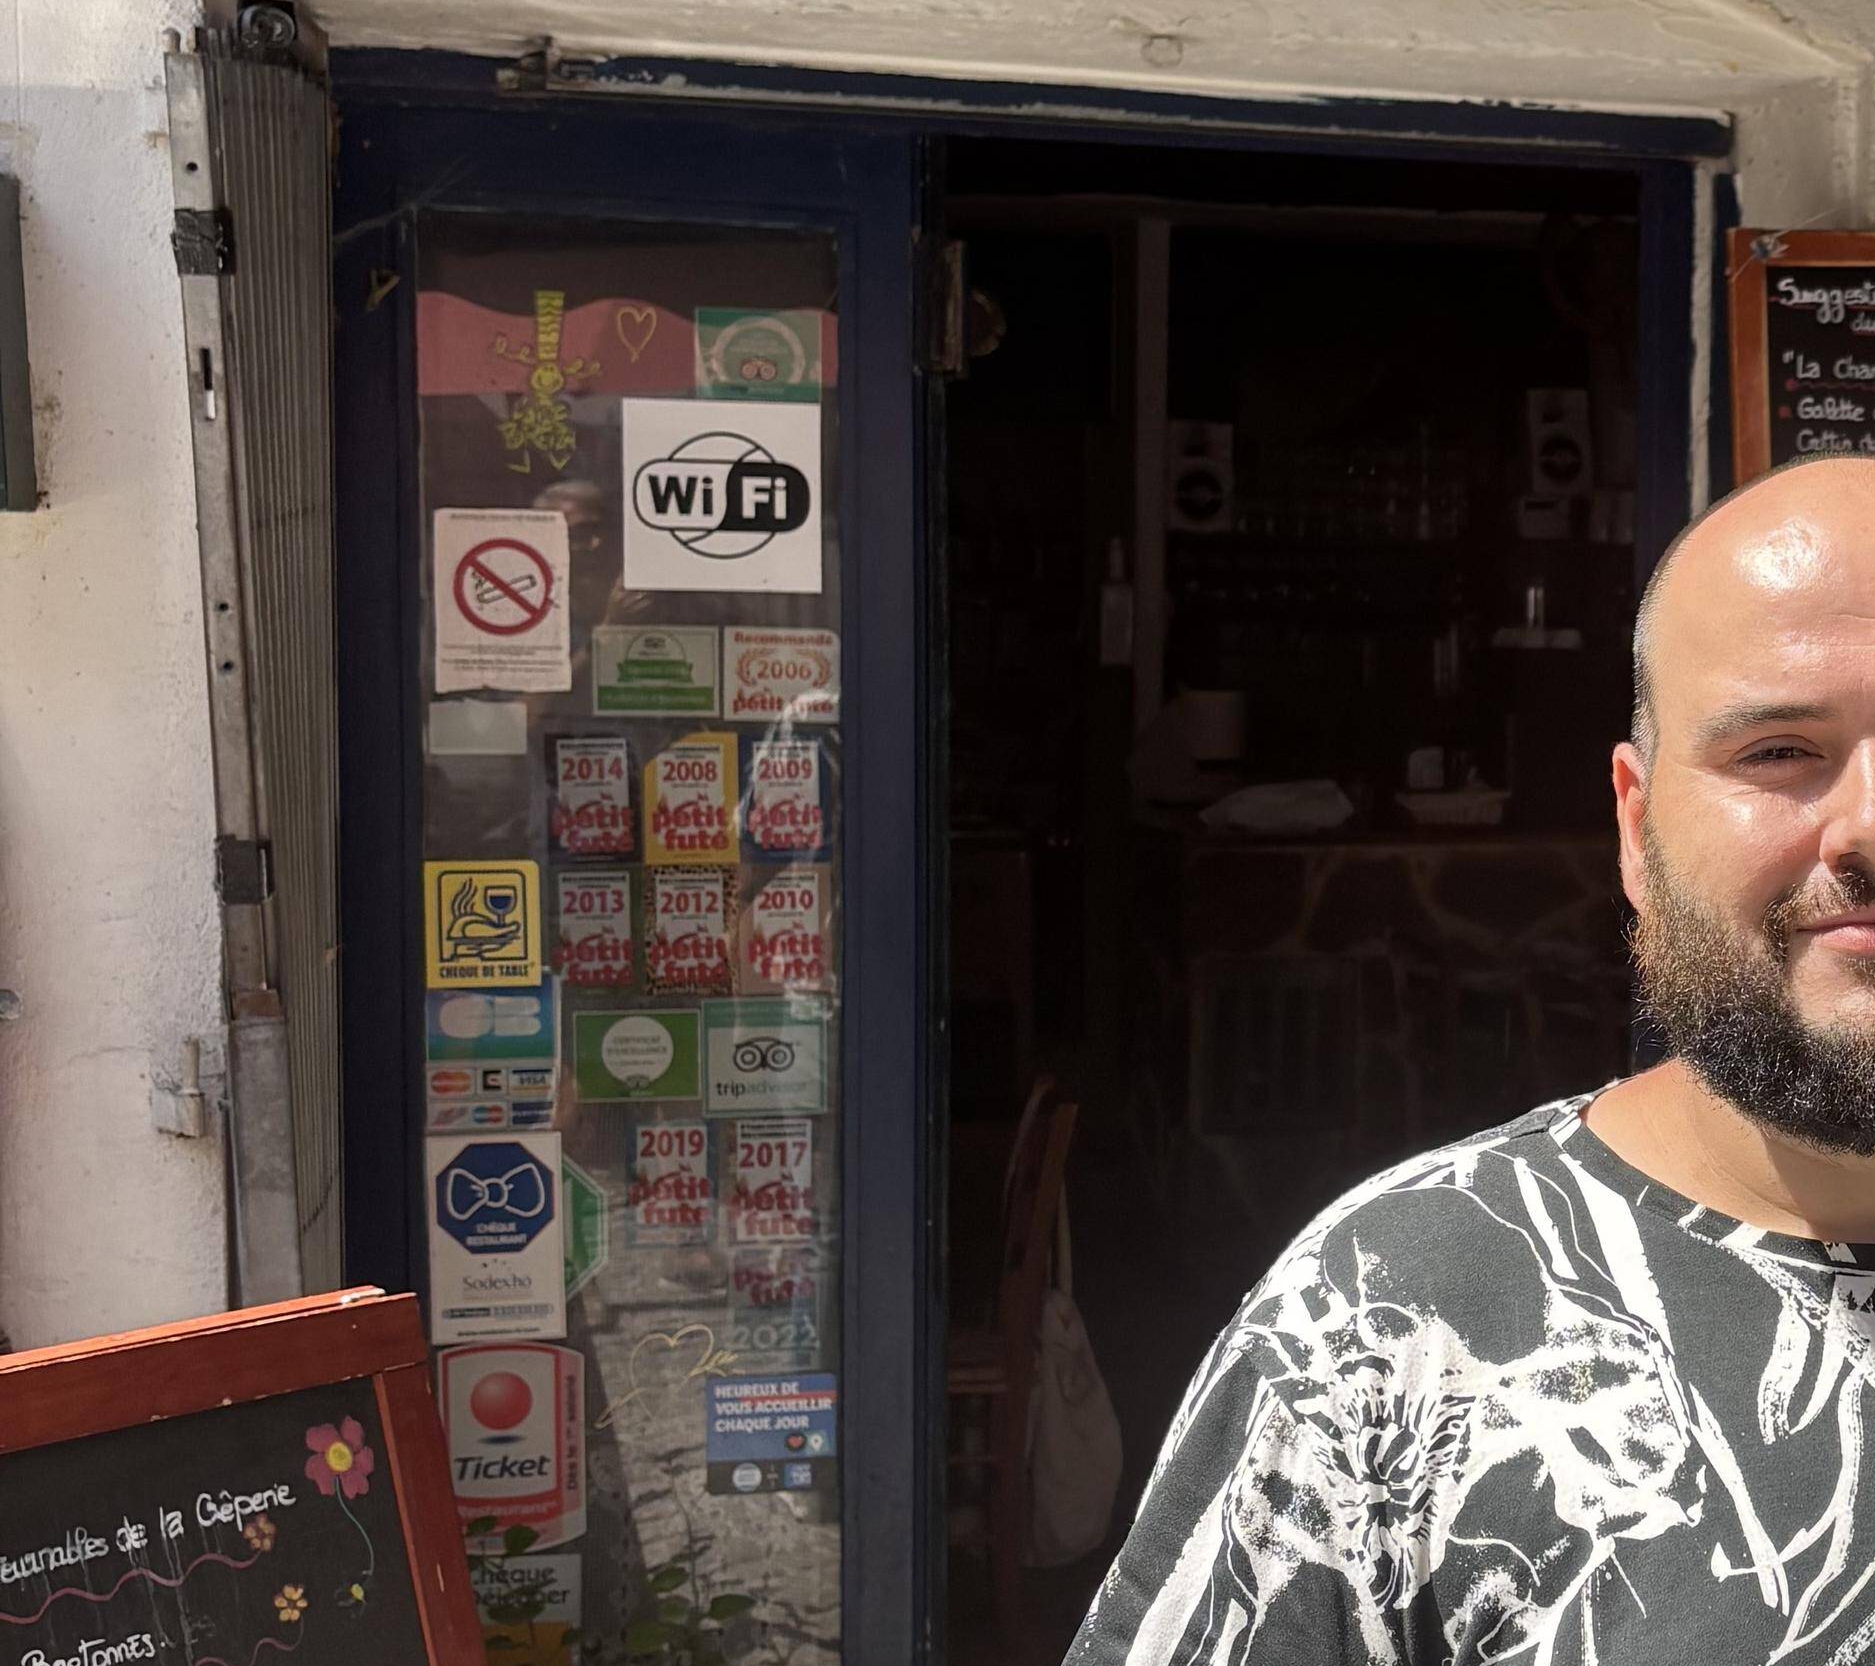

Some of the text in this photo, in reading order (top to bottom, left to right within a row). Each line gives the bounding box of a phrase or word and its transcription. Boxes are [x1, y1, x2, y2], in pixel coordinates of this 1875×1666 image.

[755, 659, 812, 681] 2006
[561, 757, 625, 781] 2014
[662, 760, 719, 782] 2008
[757, 757, 814, 780] 2009
[552, 803, 634, 834] petit
[652, 803, 730, 833] petit
[562, 890, 625, 914] 2013
[660, 890, 720, 913] 2012
[758, 888, 814, 911] 2010
[552, 936, 634, 968] petit
[650, 935, 728, 966] petit
[639, 1129, 705, 1159] 2019
[739, 1141, 808, 1169] 2017
[454, 1455, 551, 1482] Ticket
[195, 1483, 296, 1532] Crêperie
